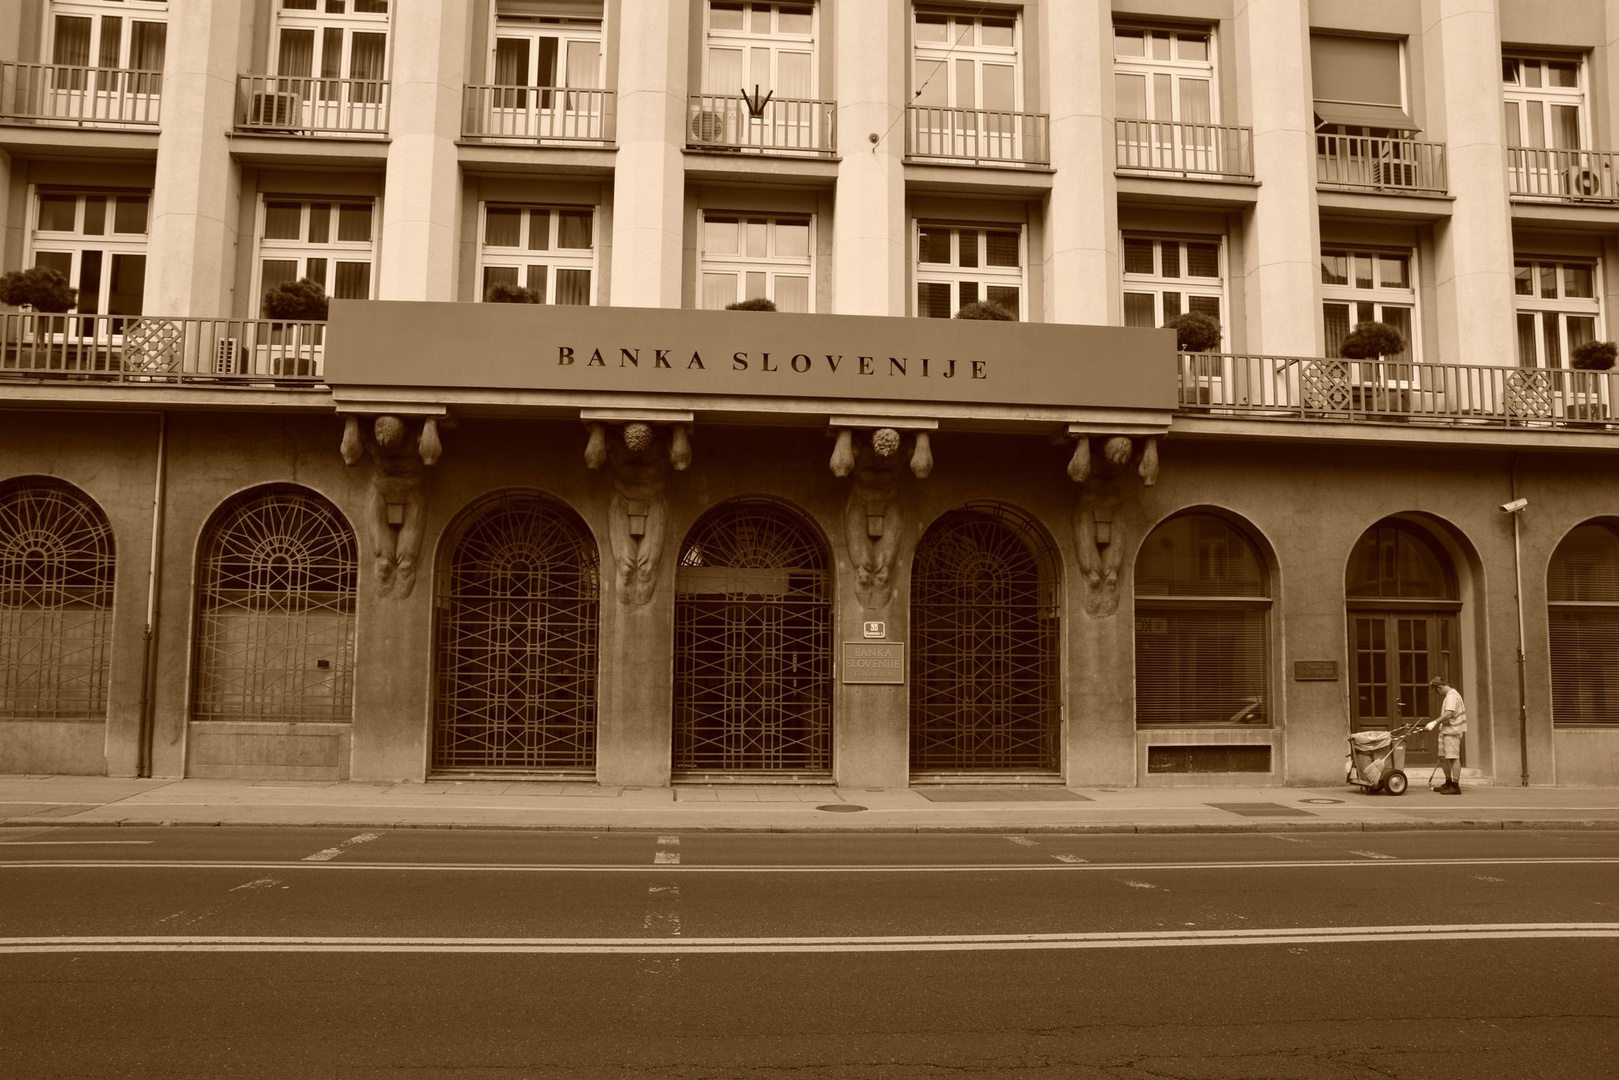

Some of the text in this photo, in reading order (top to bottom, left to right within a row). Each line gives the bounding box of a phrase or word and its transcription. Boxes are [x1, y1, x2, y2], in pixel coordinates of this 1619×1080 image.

[556, 346, 988, 380] BANKA SLOVENIJE
[854, 648, 893, 657] BANKA
[846, 658, 901, 668] SLOVENIJE
